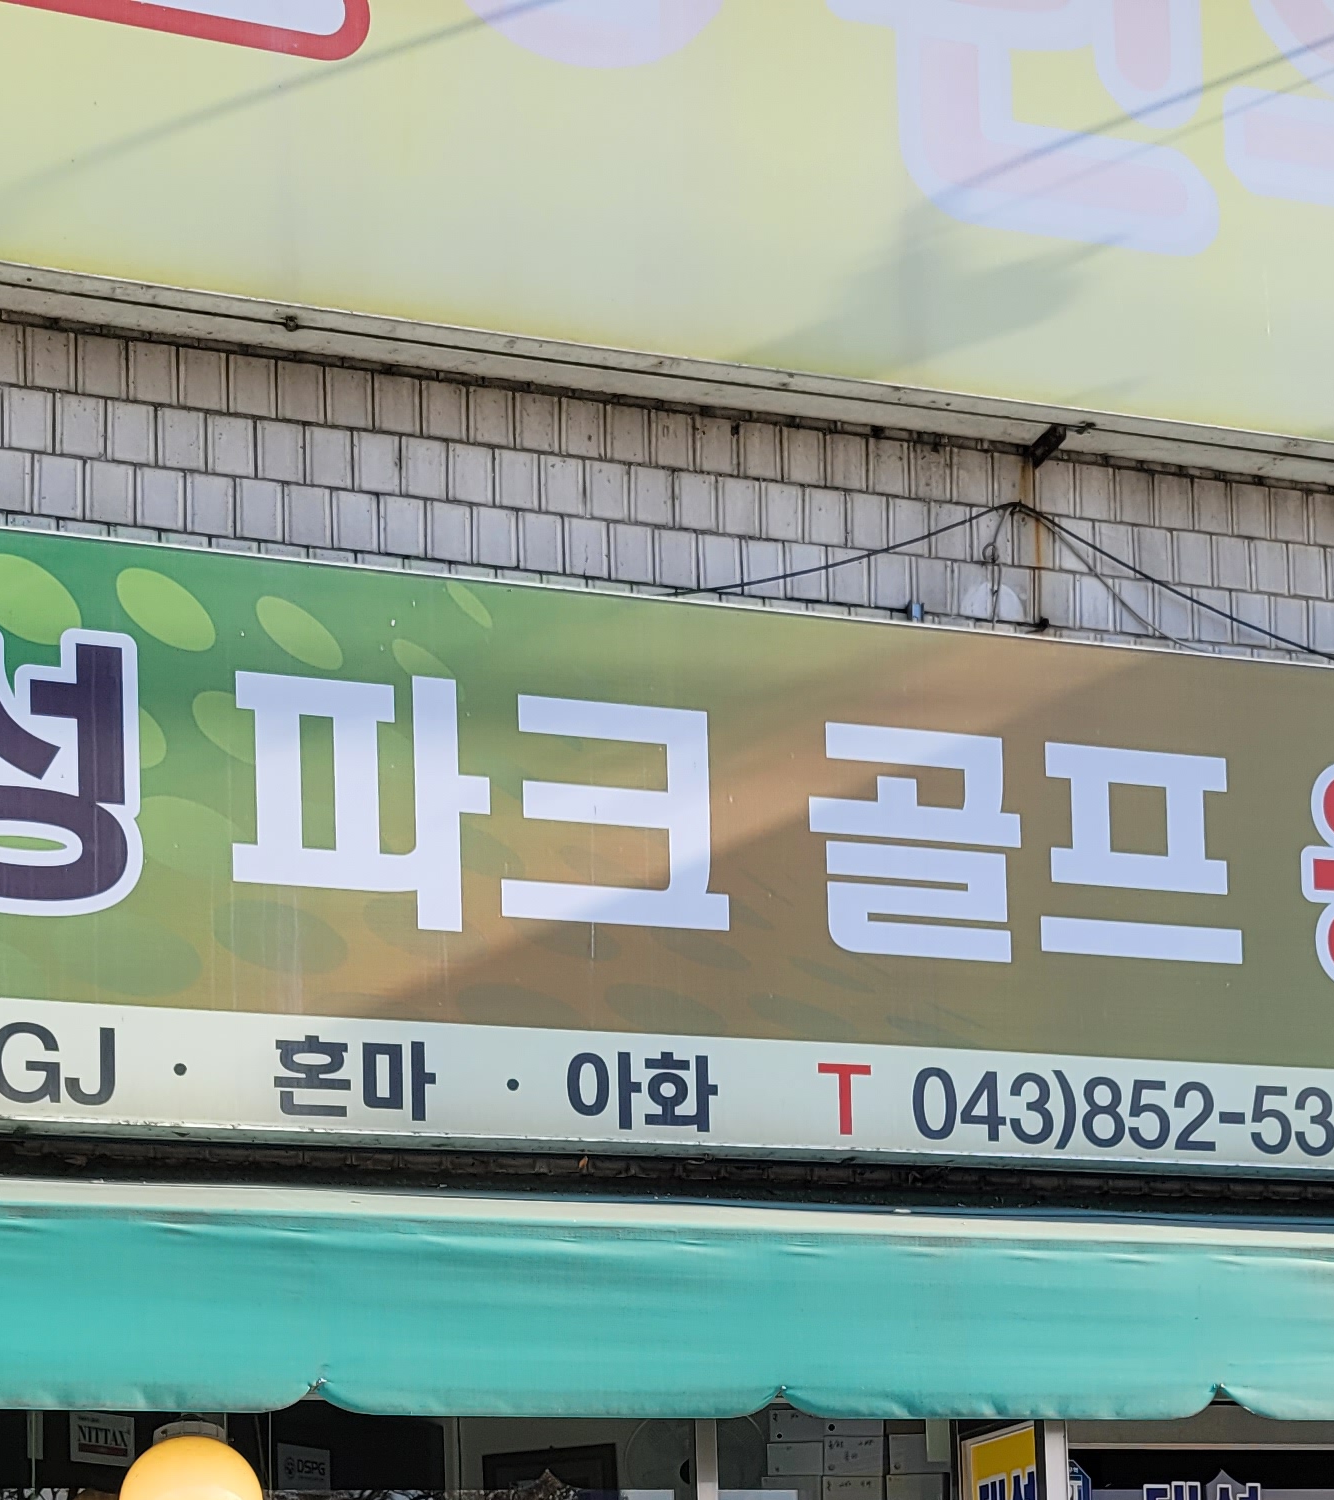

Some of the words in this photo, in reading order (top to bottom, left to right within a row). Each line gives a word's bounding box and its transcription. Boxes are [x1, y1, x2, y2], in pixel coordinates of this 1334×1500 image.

[233, 671, 731, 938] 파크
[808, 721, 1243, 965] 골프
[272, 1034, 437, 1123] 혼마
[565, 1051, 719, 1134] 아화
[817, 1062, 871, 1136] T
